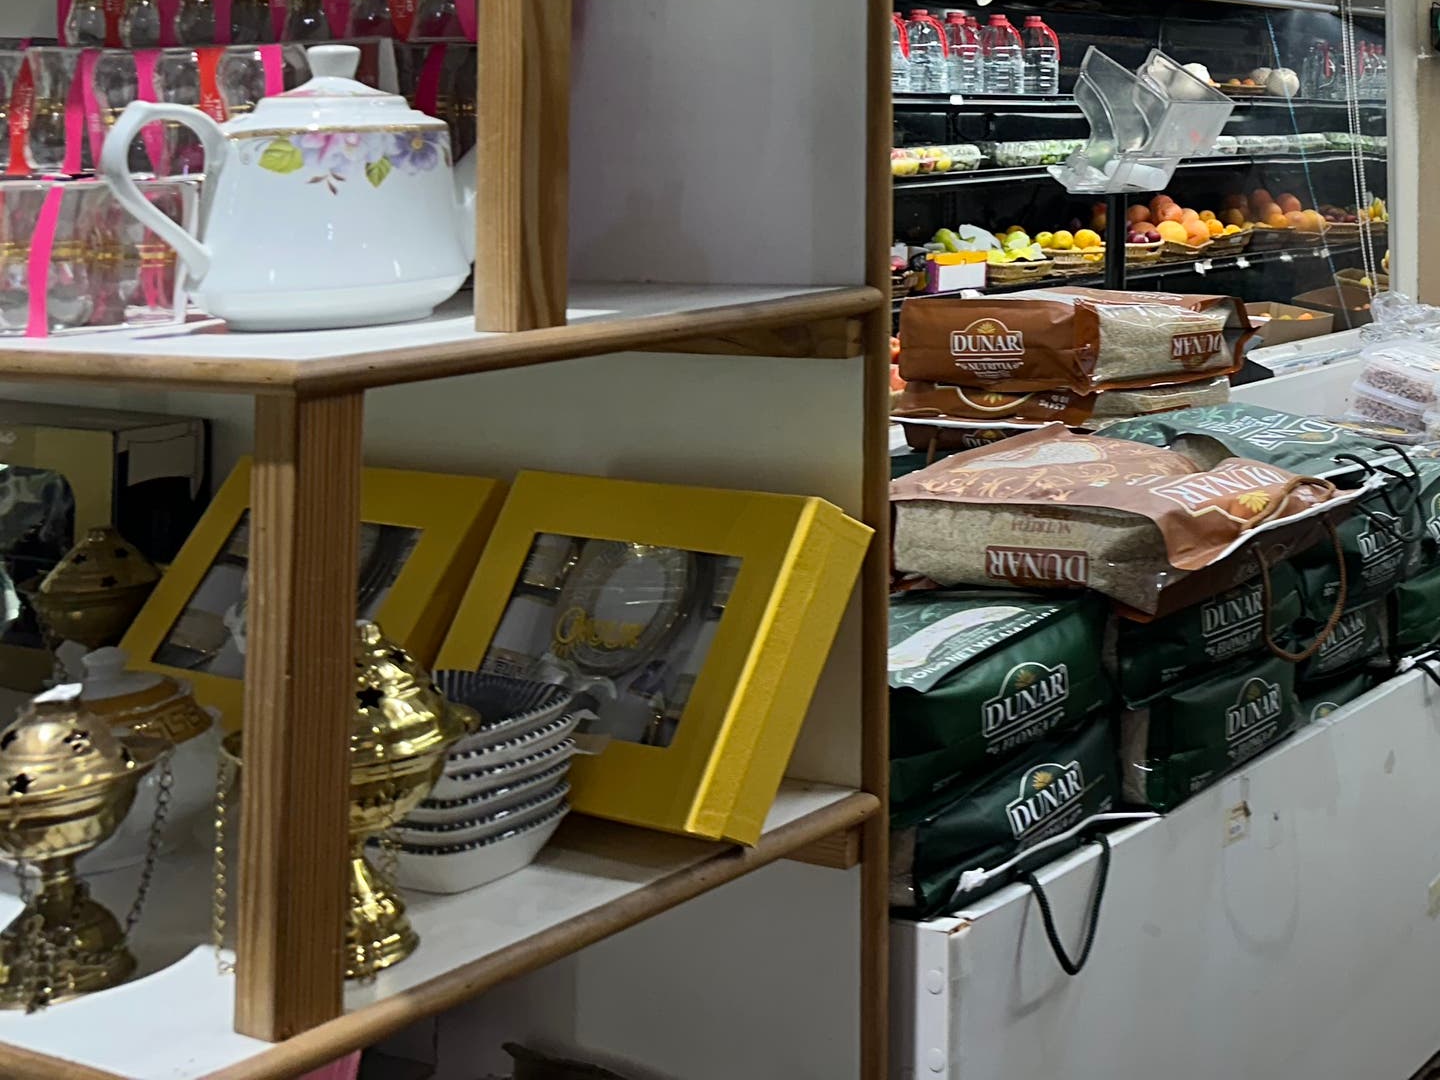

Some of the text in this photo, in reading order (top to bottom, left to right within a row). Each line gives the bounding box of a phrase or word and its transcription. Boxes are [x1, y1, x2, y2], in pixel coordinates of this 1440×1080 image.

[953, 334, 1022, 352] DUNAR
[1172, 333, 1222, 359] DUNAR
[1169, 466, 1287, 507] DUNAR
[987, 549, 1087, 583] DUNAR
[1204, 591, 1264, 631] DUNAR
[947, 645, 978, 665] NET
[985, 672, 1066, 732] DUNAR
[1228, 690, 1281, 735] DUNAR
[1010, 770, 1083, 833] DUNAR
